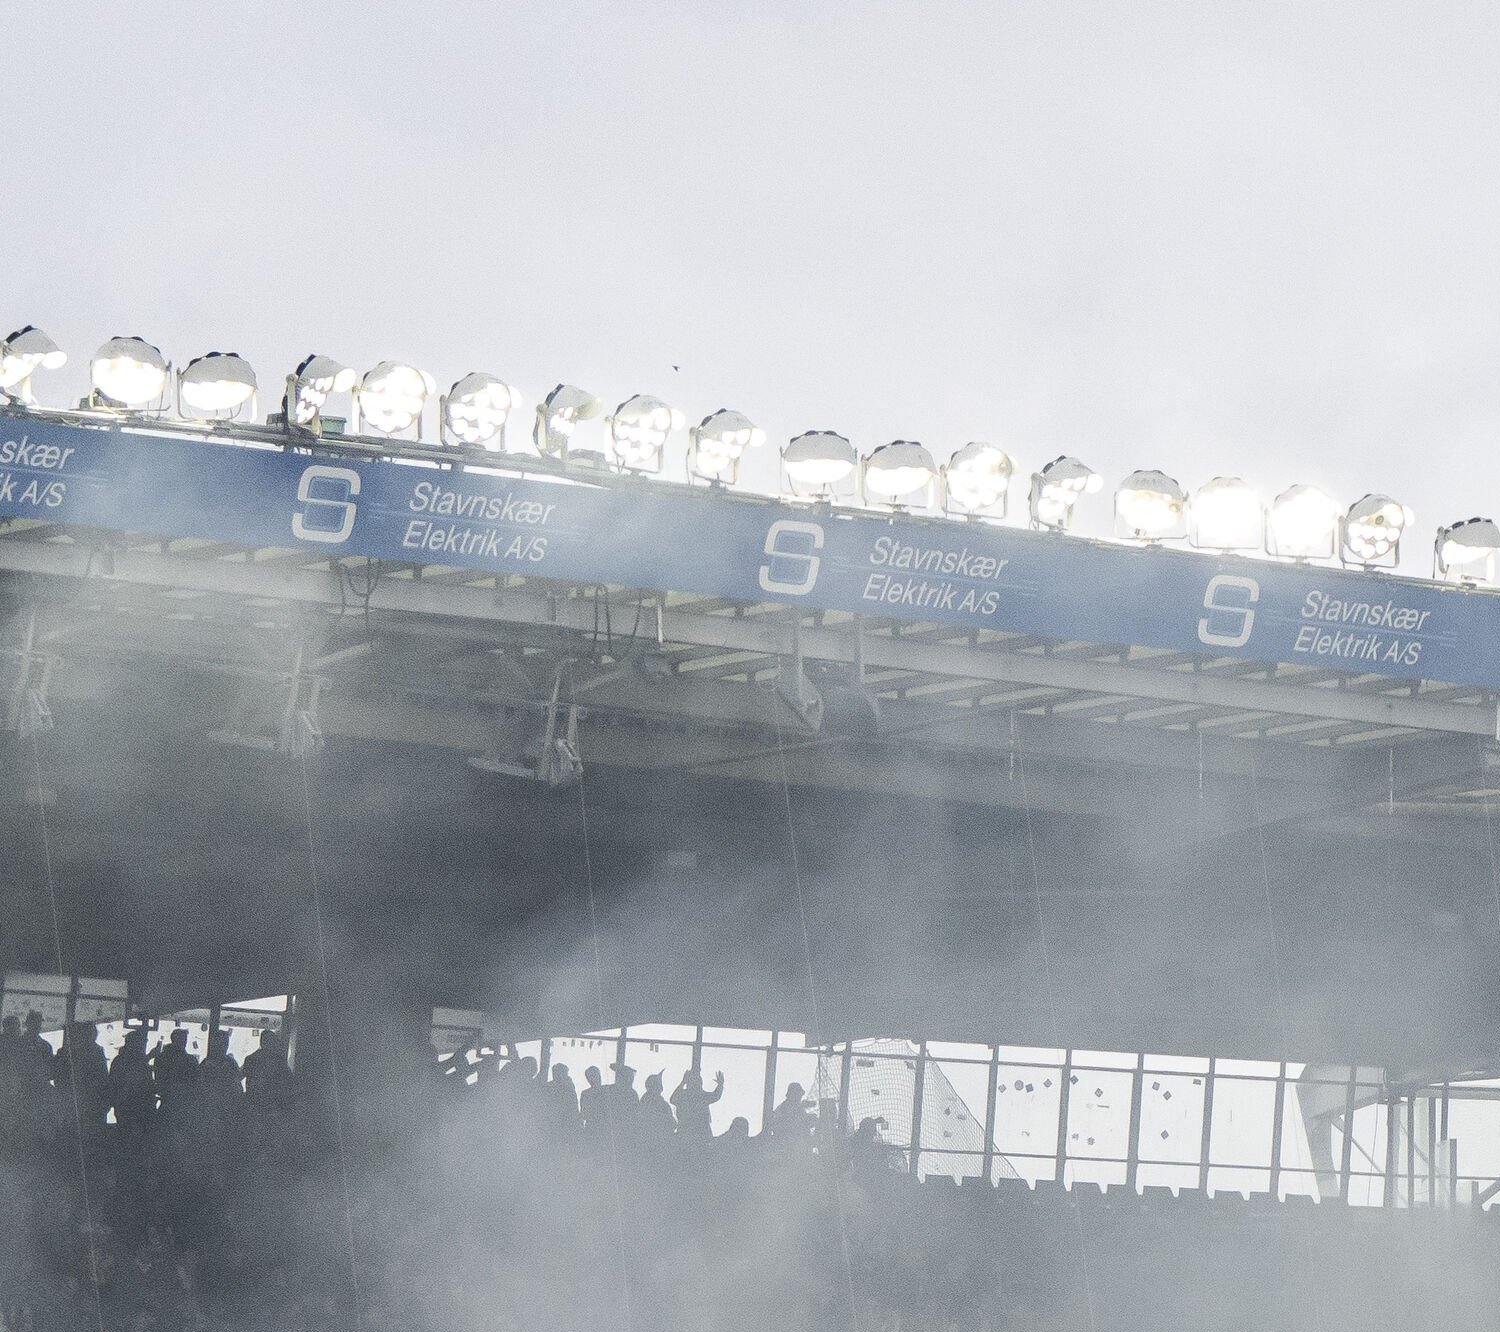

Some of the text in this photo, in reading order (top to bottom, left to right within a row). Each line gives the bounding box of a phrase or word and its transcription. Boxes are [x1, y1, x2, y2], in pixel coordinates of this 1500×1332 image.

[19, 480, 66, 507] A/S
[409, 481, 555, 527] Stavnskær
[403, 520, 547, 562] Elektrik A/S
[869, 537, 1009, 582] Stavnskær
[863, 573, 1000, 615] Elektrik A/S
[1301, 590, 1431, 632] Stavnskær
[1294, 626, 1422, 667] Elektrik A/S
